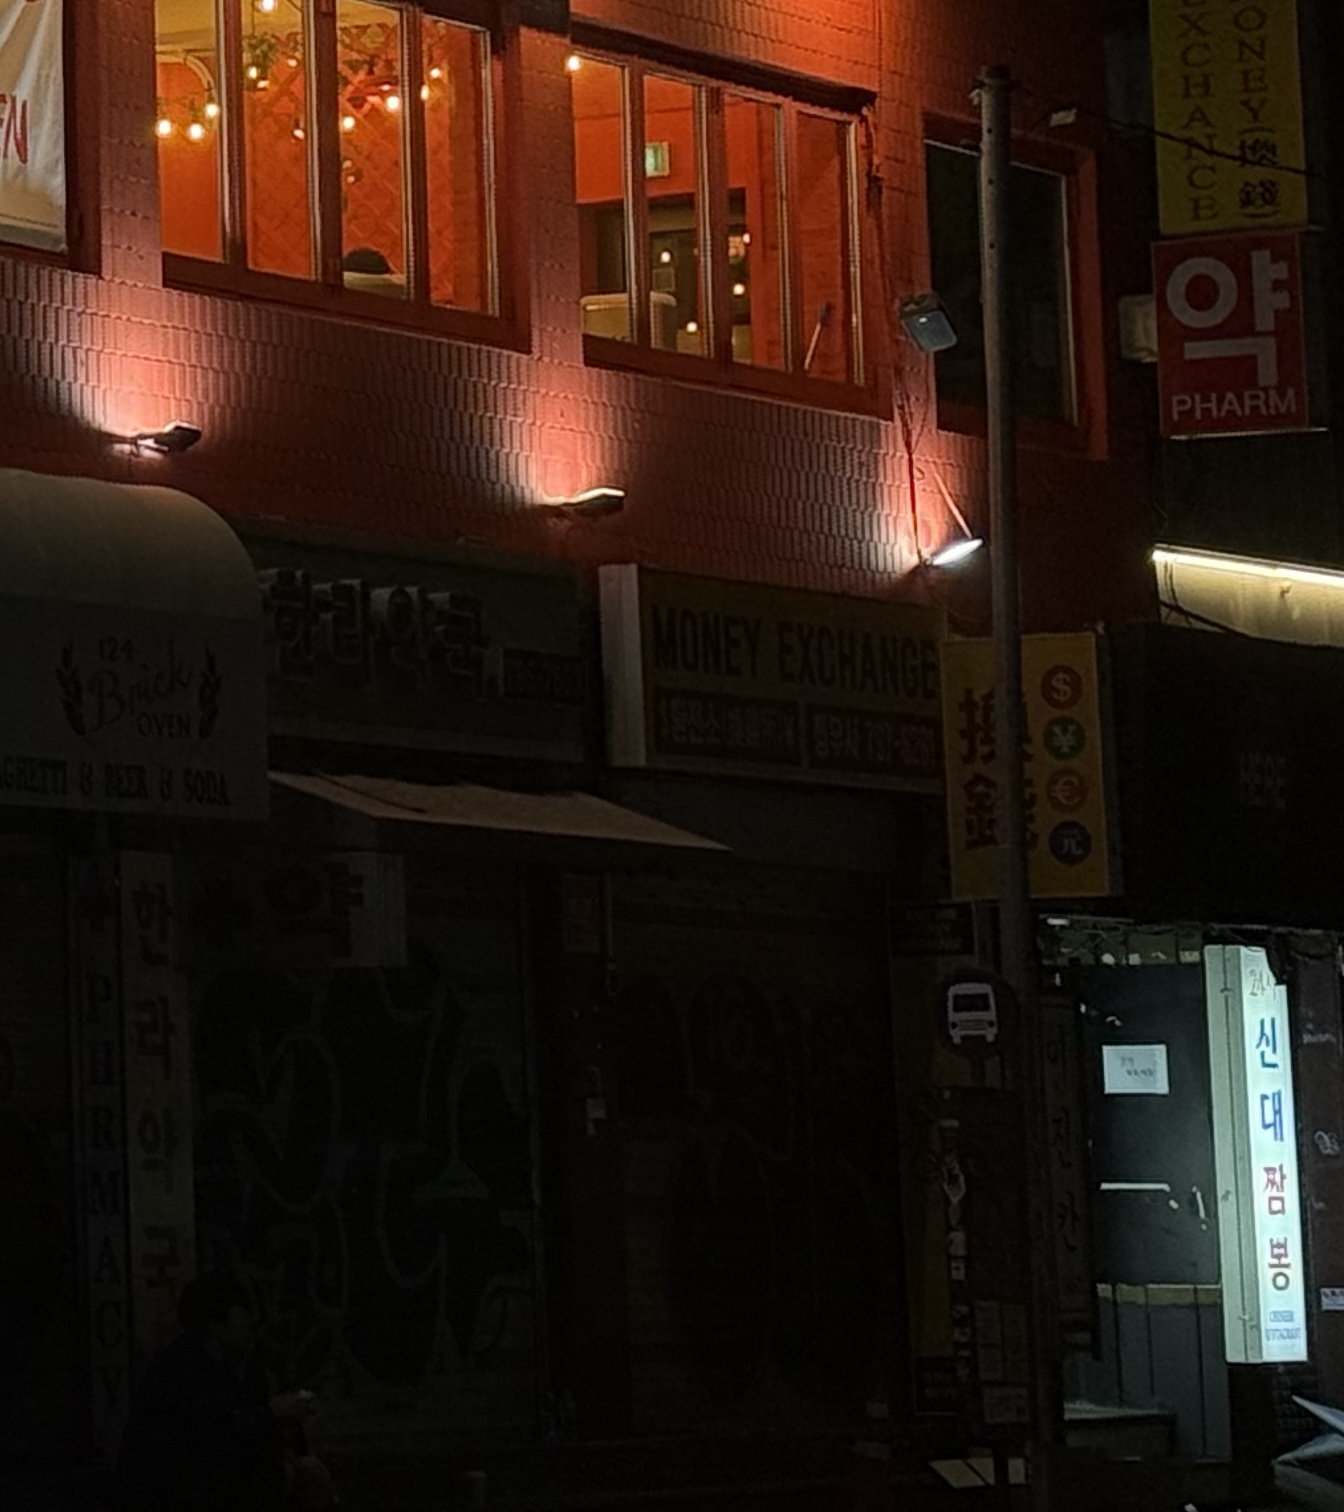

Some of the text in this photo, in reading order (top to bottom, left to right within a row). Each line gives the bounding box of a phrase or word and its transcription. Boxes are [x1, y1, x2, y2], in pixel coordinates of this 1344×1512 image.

[1166, 248, 1292, 388] 약
[1170, 387, 1299, 424] PHARM
[651, 602, 762, 679] MONEY
[777, 619, 938, 701] EXCHANGE
[136, 712, 191, 738] OVEN
[183, 768, 231, 807] SODA
